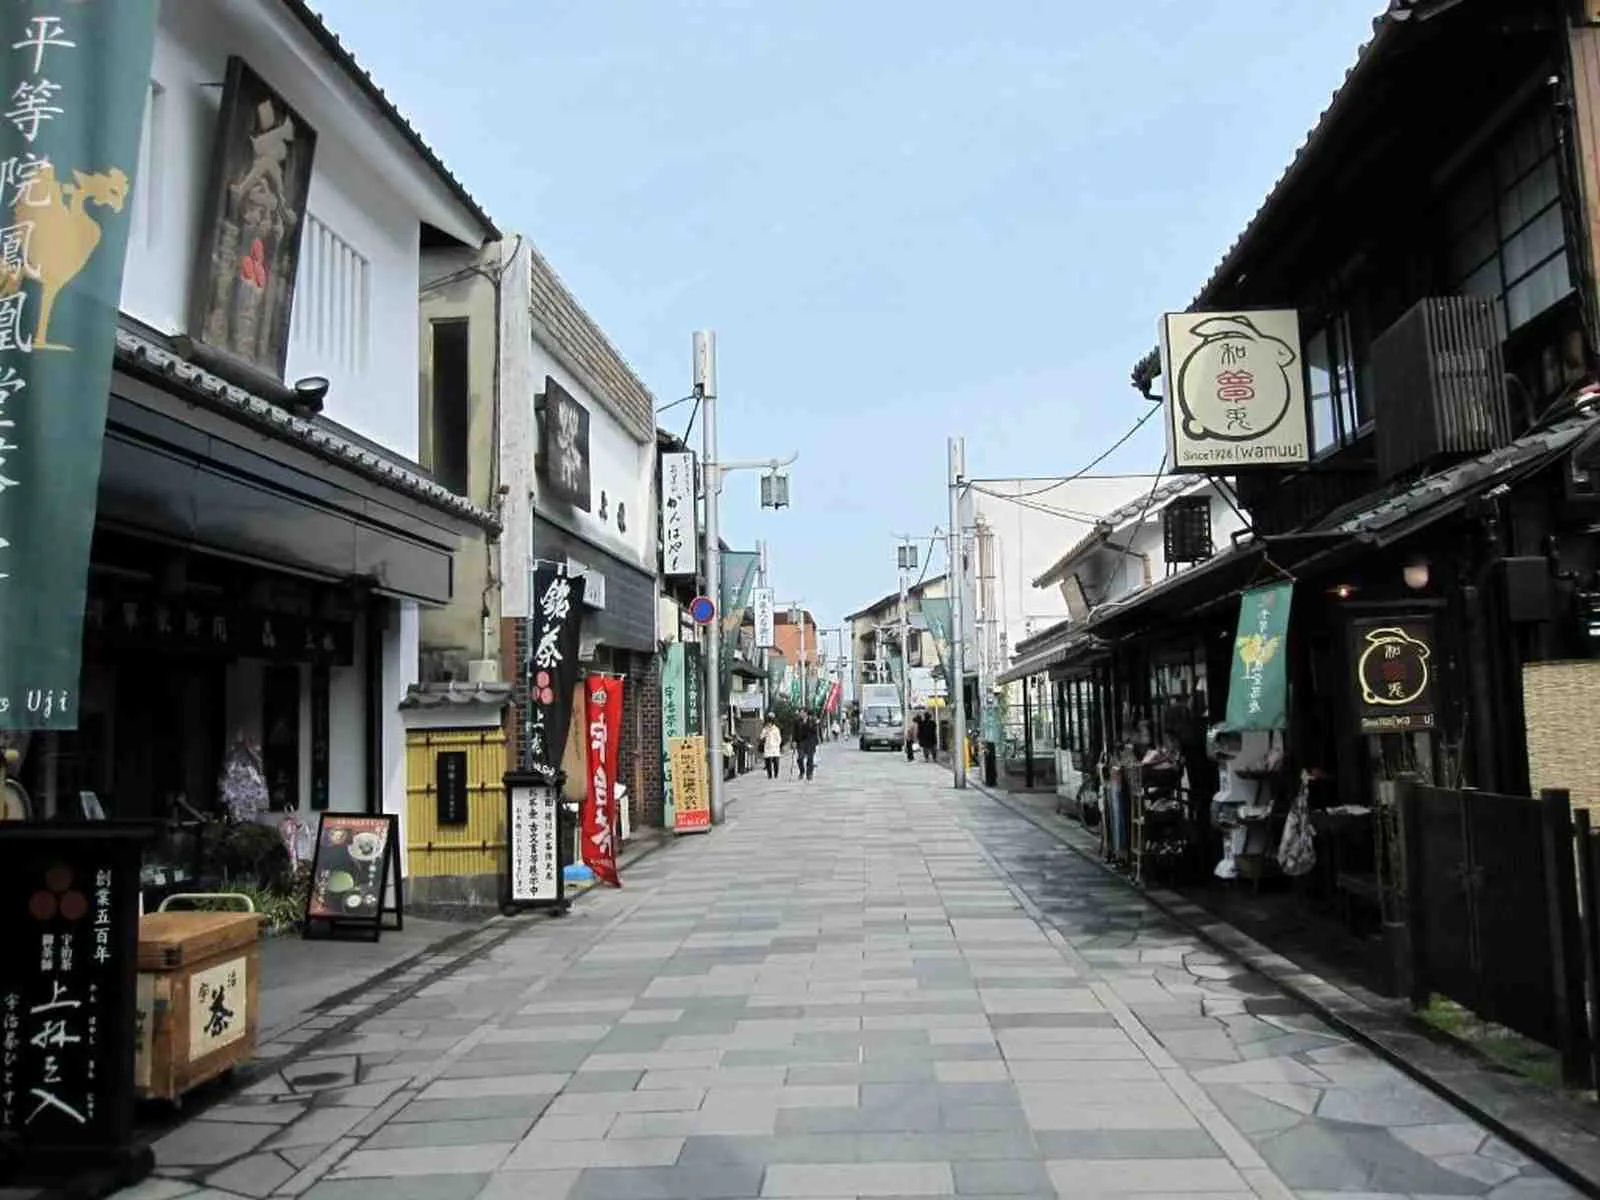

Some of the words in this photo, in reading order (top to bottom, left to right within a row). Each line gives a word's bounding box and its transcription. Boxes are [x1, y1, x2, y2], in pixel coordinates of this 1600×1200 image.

[27, 689, 69, 718] Uji
[93, 869, 112, 964] 創業五百年
